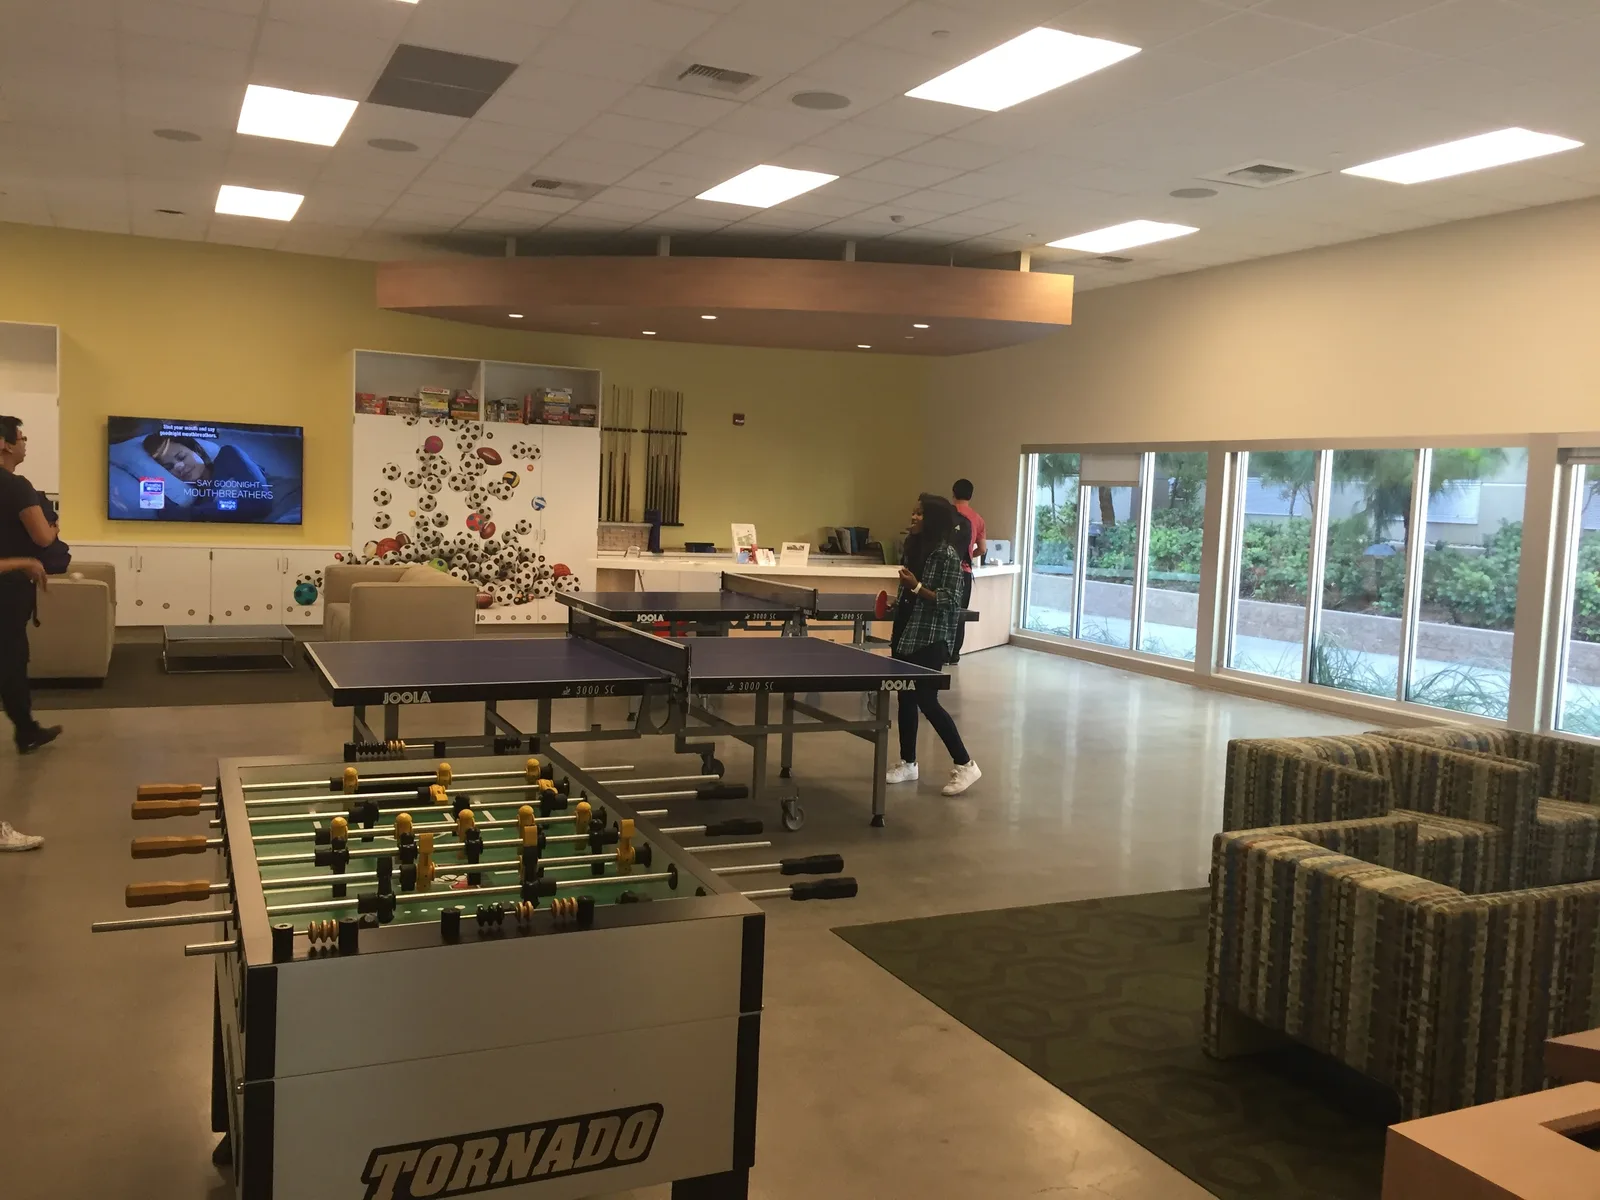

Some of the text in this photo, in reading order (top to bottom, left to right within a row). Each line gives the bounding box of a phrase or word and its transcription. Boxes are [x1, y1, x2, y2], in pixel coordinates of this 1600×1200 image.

[196, 479, 260, 489] SAY GOODNIGHT
[183, 488, 274, 499] MOUTHBREATHERS
[636, 613, 665, 622] JOOLA
[576, 684, 615, 695] 3000 SC
[738, 681, 774, 691] 3000 SC
[880, 679, 916, 691] JOOLA
[382, 691, 431, 705] JOOLA
[365, 1108, 658, 1200] TORNADO
